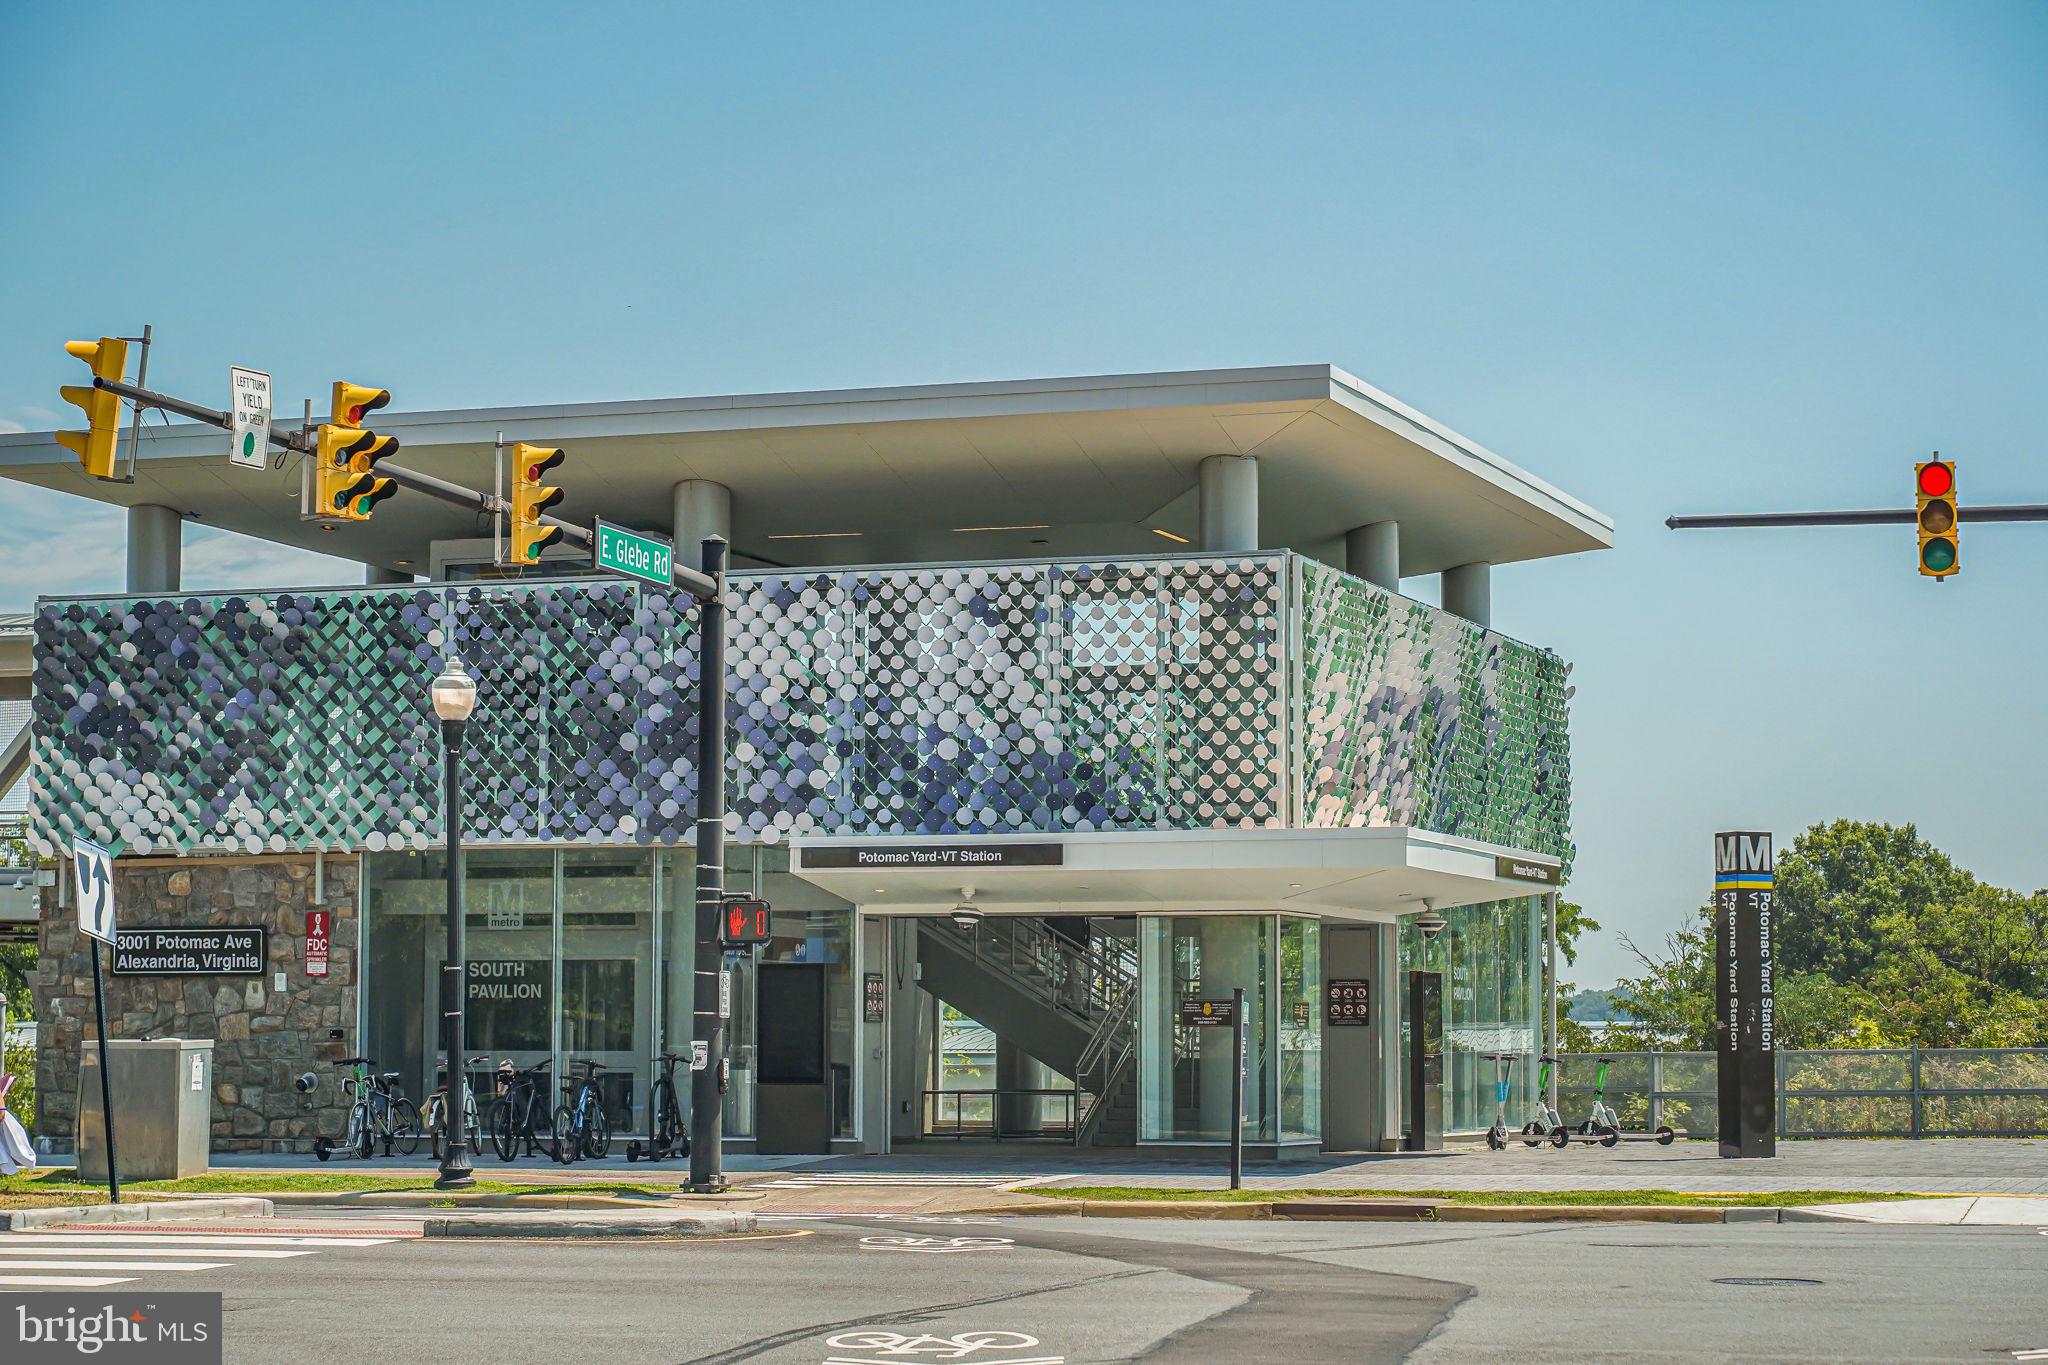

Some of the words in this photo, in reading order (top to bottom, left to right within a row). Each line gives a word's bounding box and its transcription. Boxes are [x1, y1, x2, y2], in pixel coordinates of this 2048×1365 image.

[236, 375, 250, 388] LEFT
[250, 378, 267, 392] TURN
[242, 392, 263, 410] YIELD
[239, 411, 248, 423] ON
[249, 413, 265, 427] GREEN
[602, 534, 612, 560] E.
[616, 539, 650, 571] Glebe
[654, 550, 668, 577] Rd
[858, 851, 910, 863] Potomac
[911, 850, 958, 862] Yard-VT
[960, 850, 1002, 862] Station
[1740, 835, 1770, 871] M
[1721, 892, 1728, 909] VT
[1749, 892, 1759, 909] VT
[491, 918, 520, 927] metro
[1728, 892, 1737, 957] Potomac
[1760, 892, 1771, 958] Potomac
[117, 935, 150, 950] 3001
[156, 934, 220, 950] Potomac
[224, 934, 252, 949] Ave
[306, 938, 328, 951] FDC
[117, 954, 200, 971] Alexandria,
[202, 953, 259, 971] Virginia
[469, 962, 525, 977] SOUTH
[1729, 960, 1738, 993] Yard
[1761, 960, 1772, 993] Yard
[469, 983, 542, 999] PAVILION
[1730, 998, 1739, 1051] Station
[1761, 997, 1773, 1051] Station
